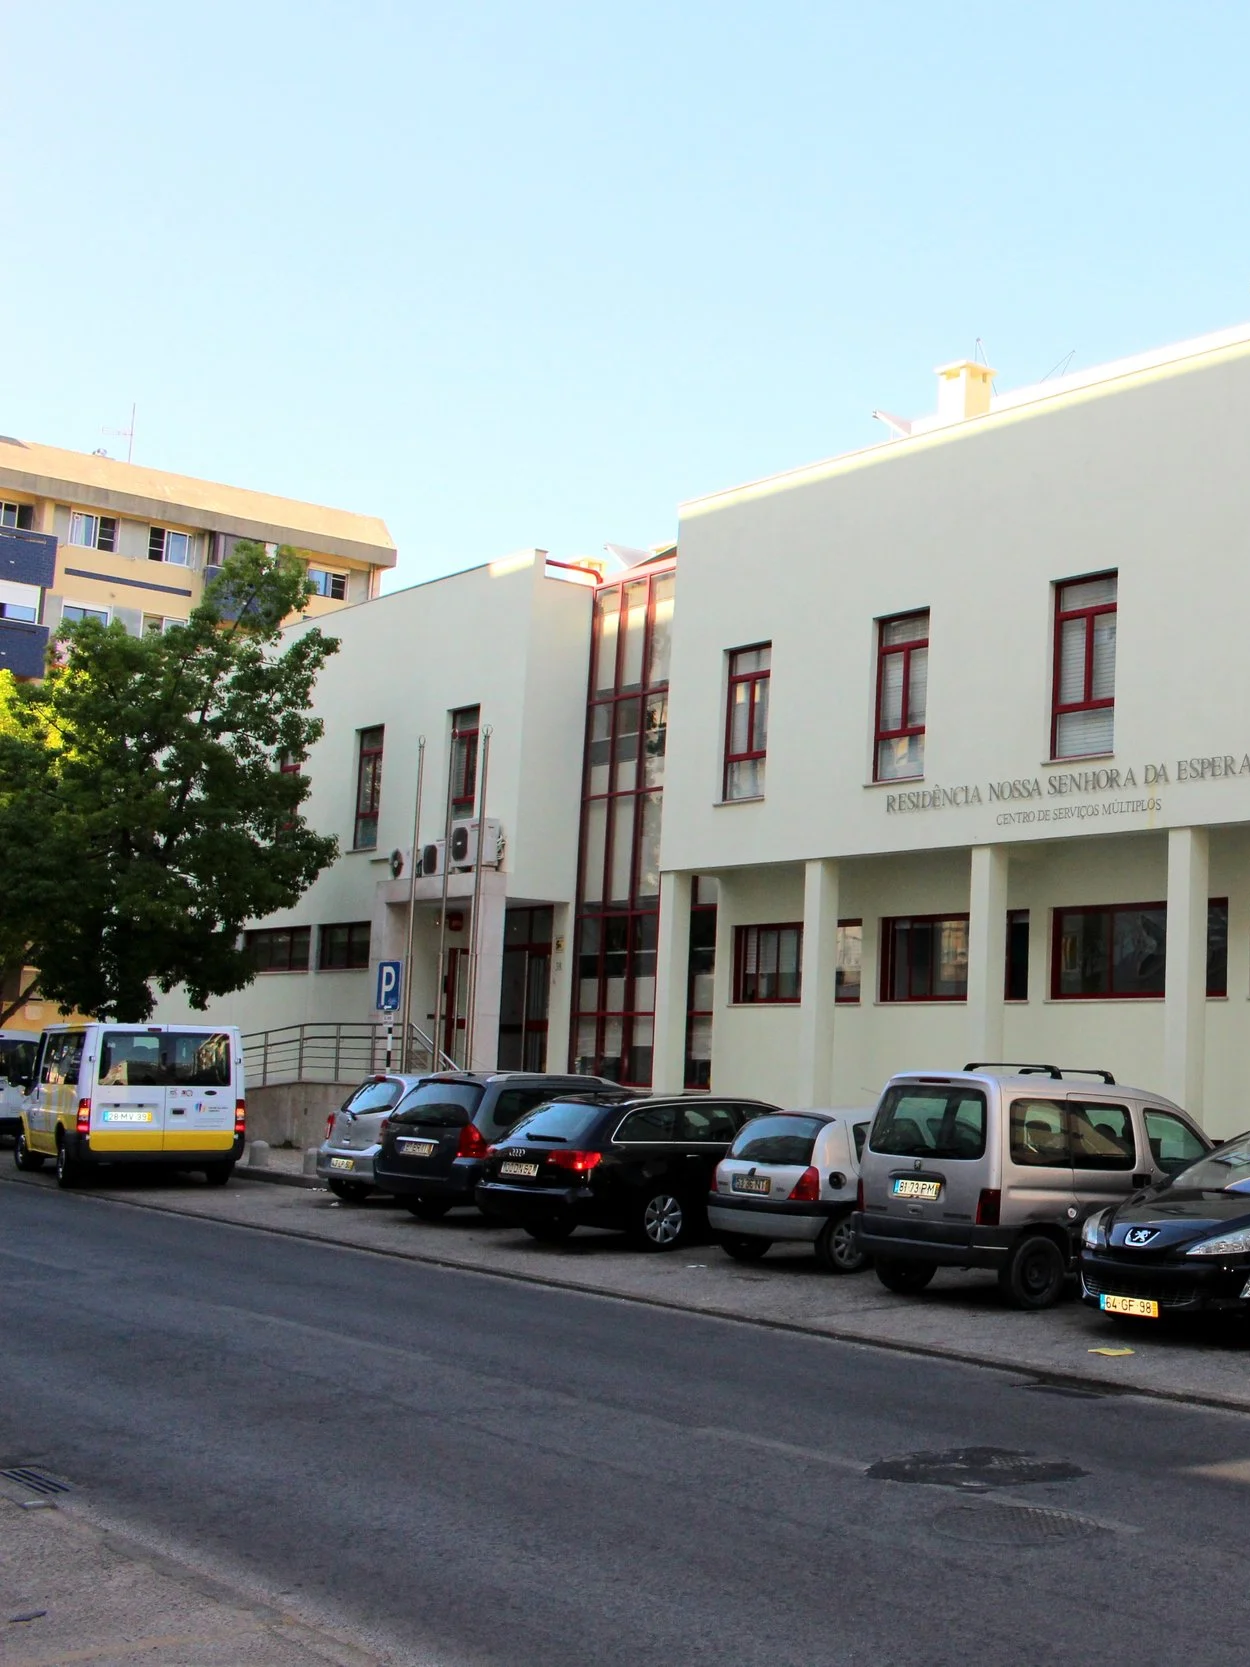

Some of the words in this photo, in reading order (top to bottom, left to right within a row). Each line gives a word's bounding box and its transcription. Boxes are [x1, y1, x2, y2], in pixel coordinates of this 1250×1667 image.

[886, 784, 983, 813] RESIDÊNCIA
[989, 778, 1042, 802] NOSSA
[1047, 767, 1137, 796] SENHORA
[1144, 763, 1169, 785] DA
[996, 811, 1036, 826] CENTRO
[1037, 809, 1051, 822] DE
[1052, 804, 1100, 820] SERVIÇOS
[1102, 799, 1162, 817] MÚLTIPLOS
[381, 966, 396, 1006] P
